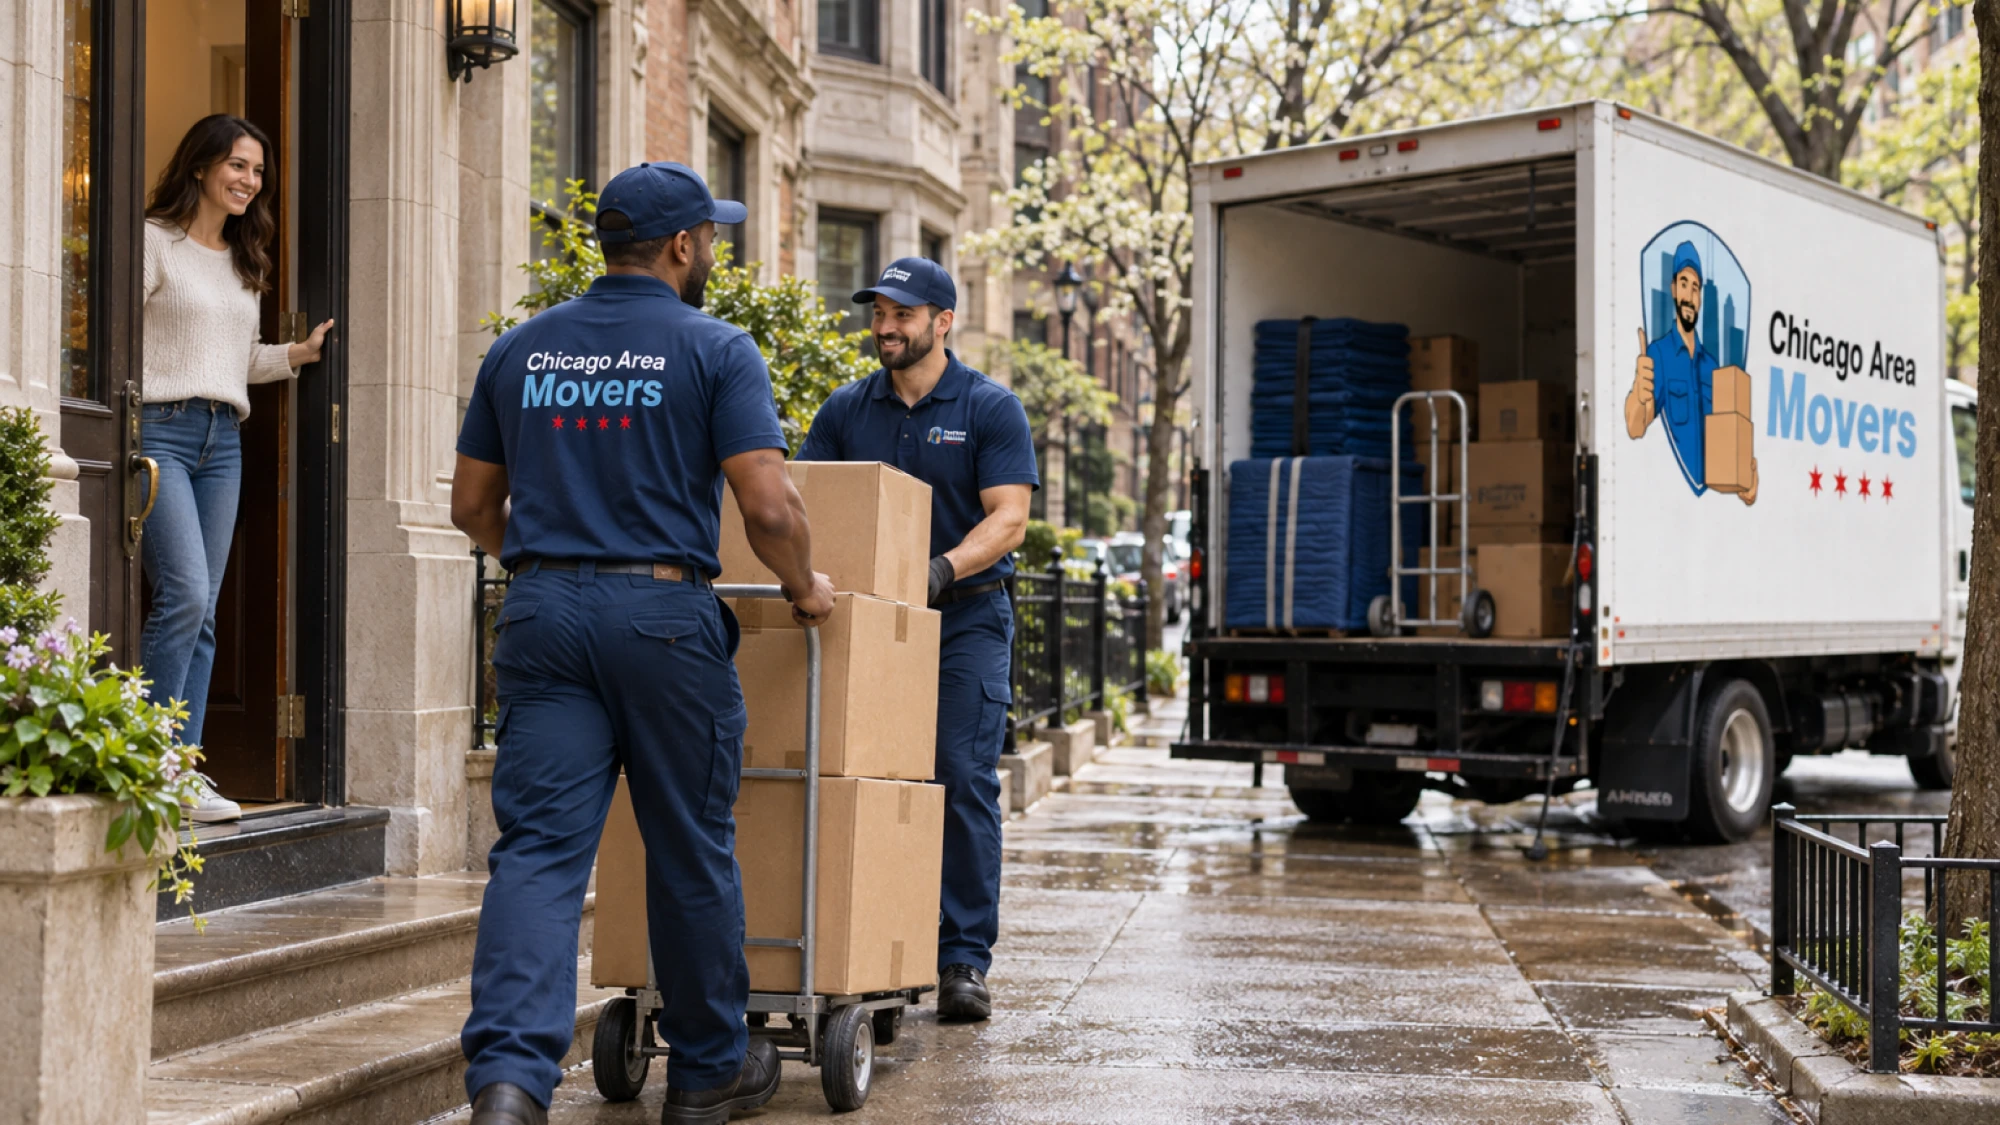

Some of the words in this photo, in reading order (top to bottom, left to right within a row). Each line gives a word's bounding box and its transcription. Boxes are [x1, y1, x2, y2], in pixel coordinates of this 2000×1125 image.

[527, 351, 611, 375] Chicago
[615, 350, 665, 371] Area
[1769, 310, 1863, 381] Chicago
[1869, 341, 1916, 387] Area
[522, 373, 663, 409] Movers
[1767, 365, 1917, 458] Movers
